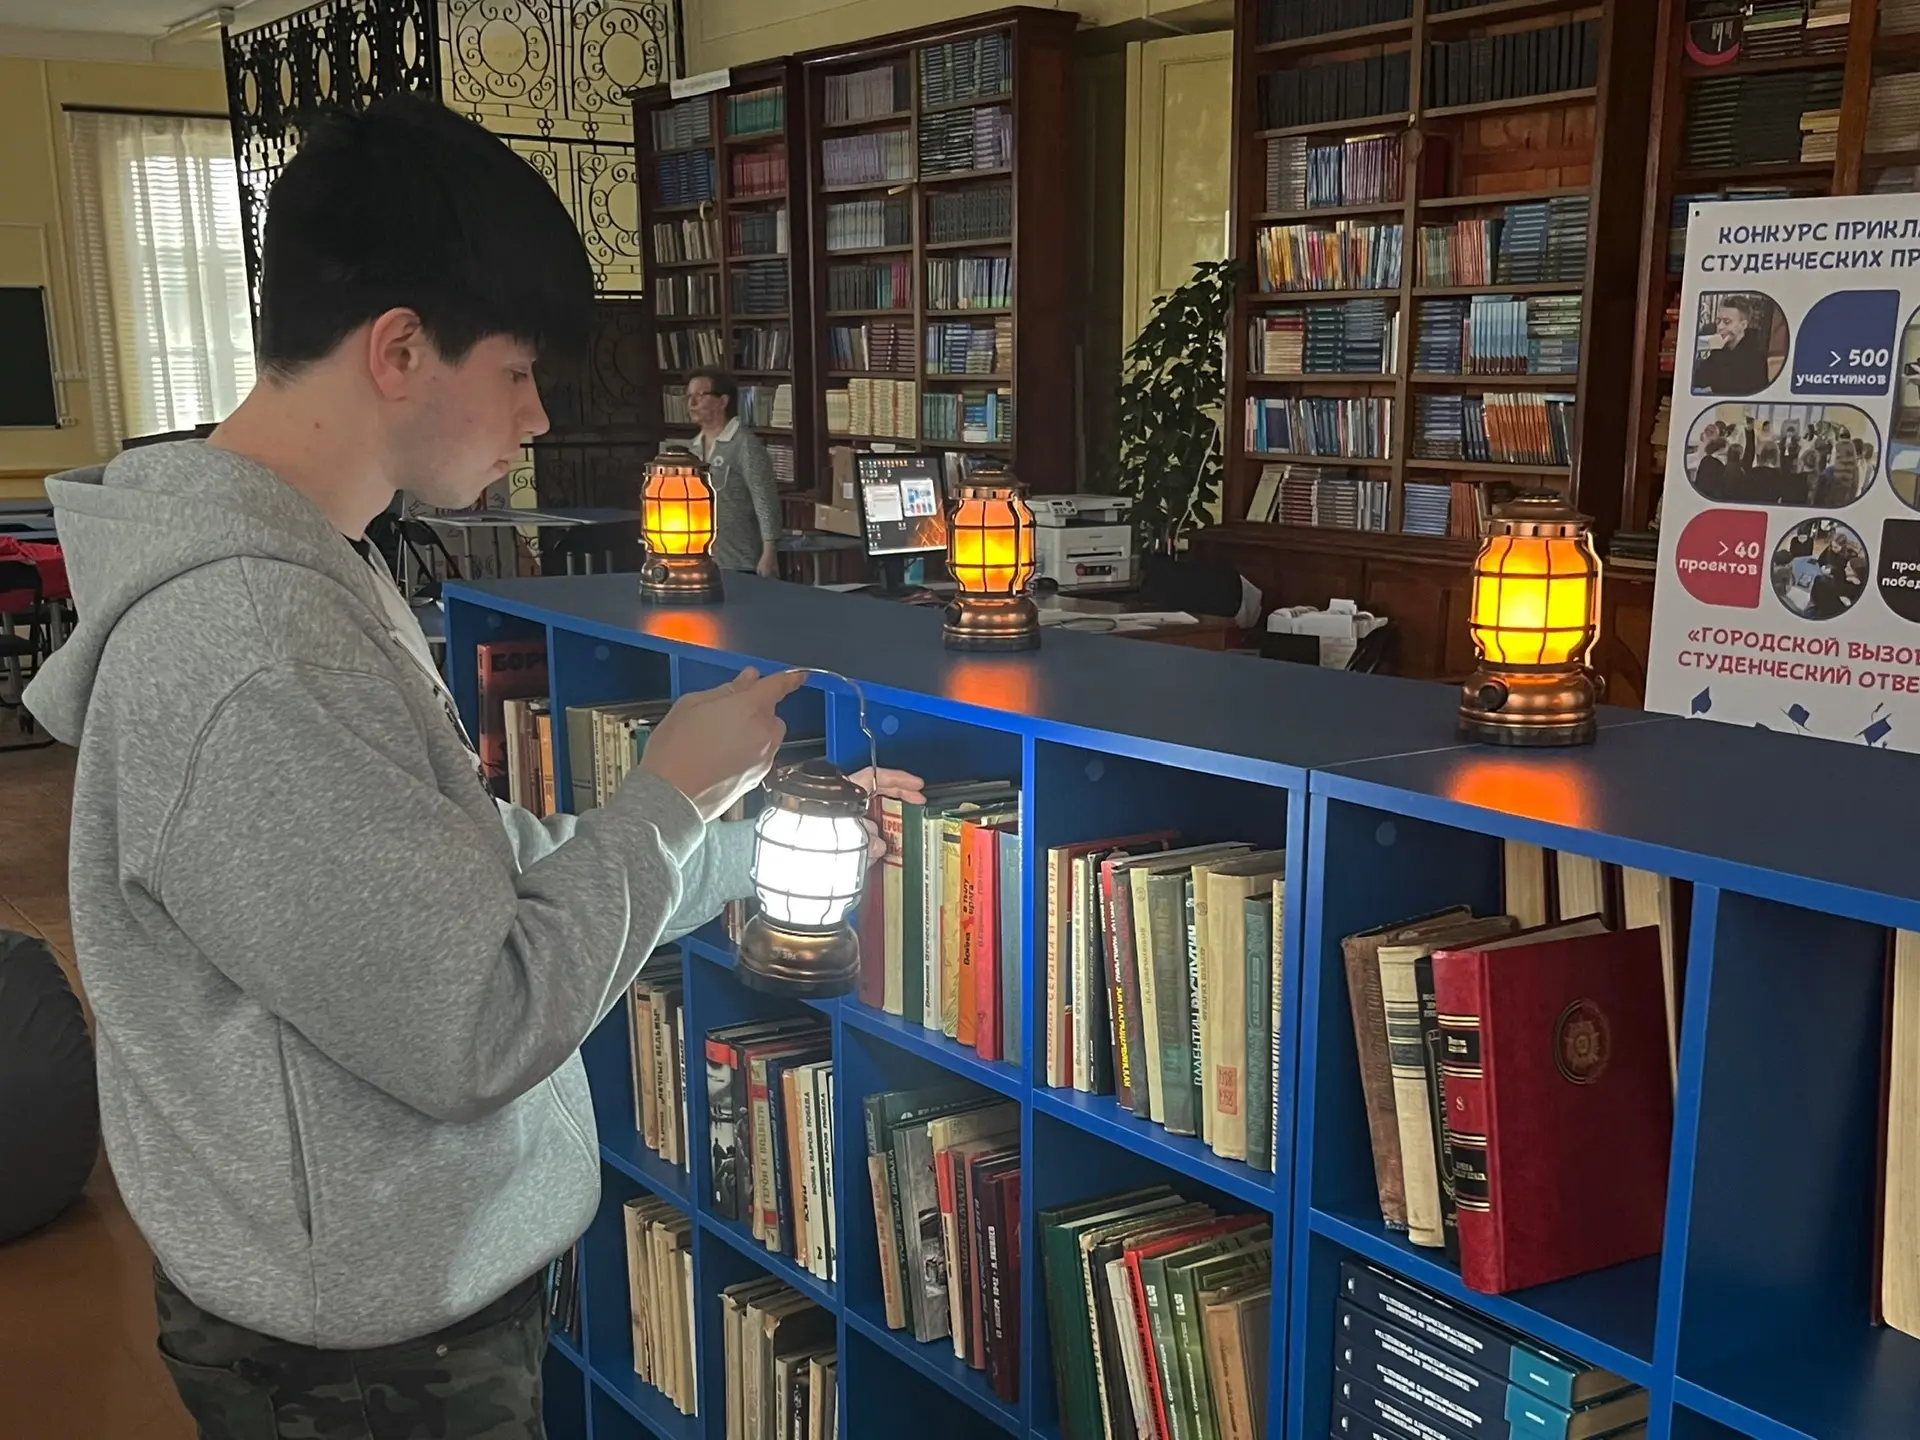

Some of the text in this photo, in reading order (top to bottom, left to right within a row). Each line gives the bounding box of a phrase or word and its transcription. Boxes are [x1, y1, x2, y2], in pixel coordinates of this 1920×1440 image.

[1718, 219, 1920, 244] КОНКУРС ПРИКЛ
[1701, 250, 1883, 274] СТУДЕНЧЕСКИХ
[1848, 349, 1889, 367] 500
[1795, 374, 1887, 386] участников
[1734, 542, 1760, 559] 40
[1679, 559, 1758, 576] проектов
[1687, 627, 1840, 658] «ГОРОДСКОЙ
[1678, 651, 1920, 694] СТУДЕНЧЕСКИЙ ОТВЕ
